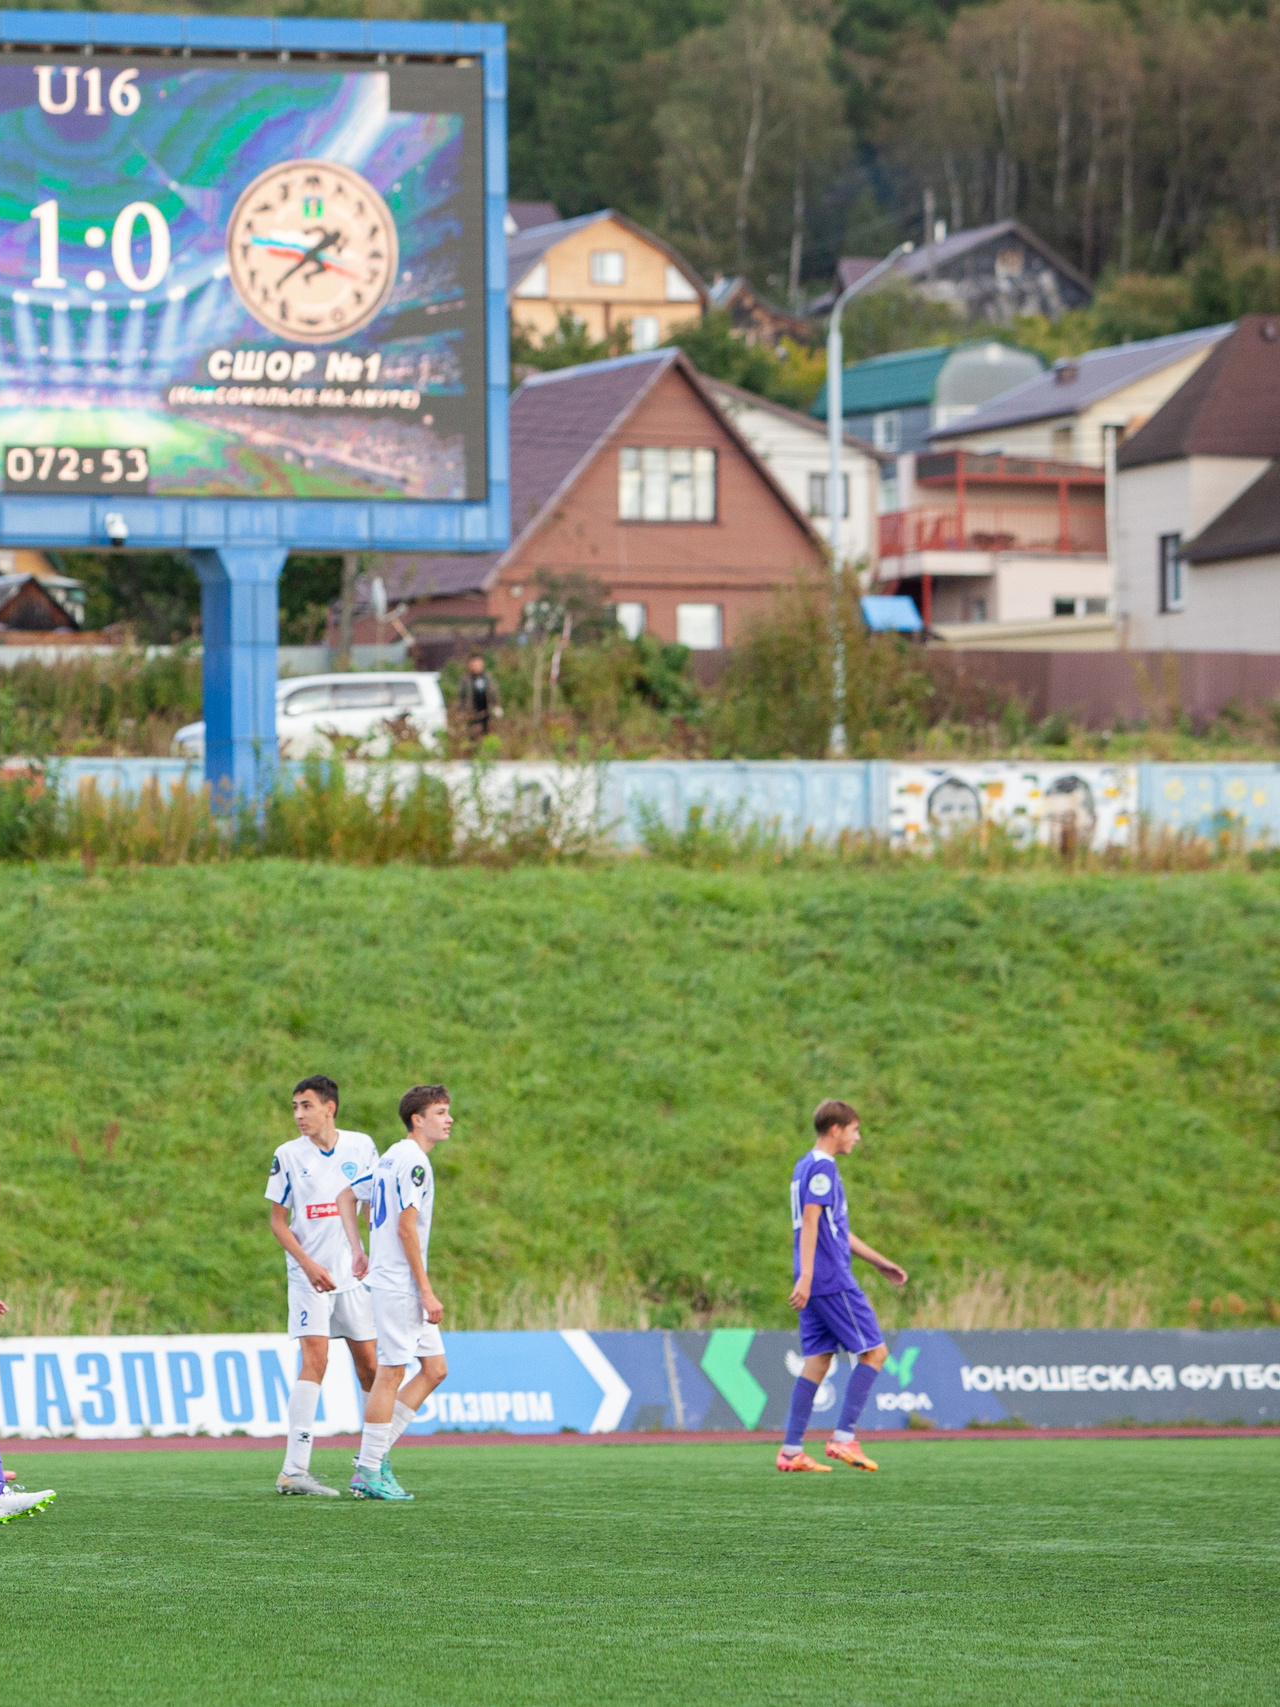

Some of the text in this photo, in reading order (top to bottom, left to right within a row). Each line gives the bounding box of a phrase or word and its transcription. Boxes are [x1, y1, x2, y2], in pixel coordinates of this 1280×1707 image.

[34, 65, 141, 116] U16
[31, 199, 171, 292] 1:0
[208, 350, 382, 383] СШОР №1
[6, 446, 149, 483] 072:53
[300, 1310, 308, 1327] 2
[960, 1364, 1177, 1392] ЮНОШЕСКАЯ
[435, 1391, 555, 1423] ГАЗПРОМ
